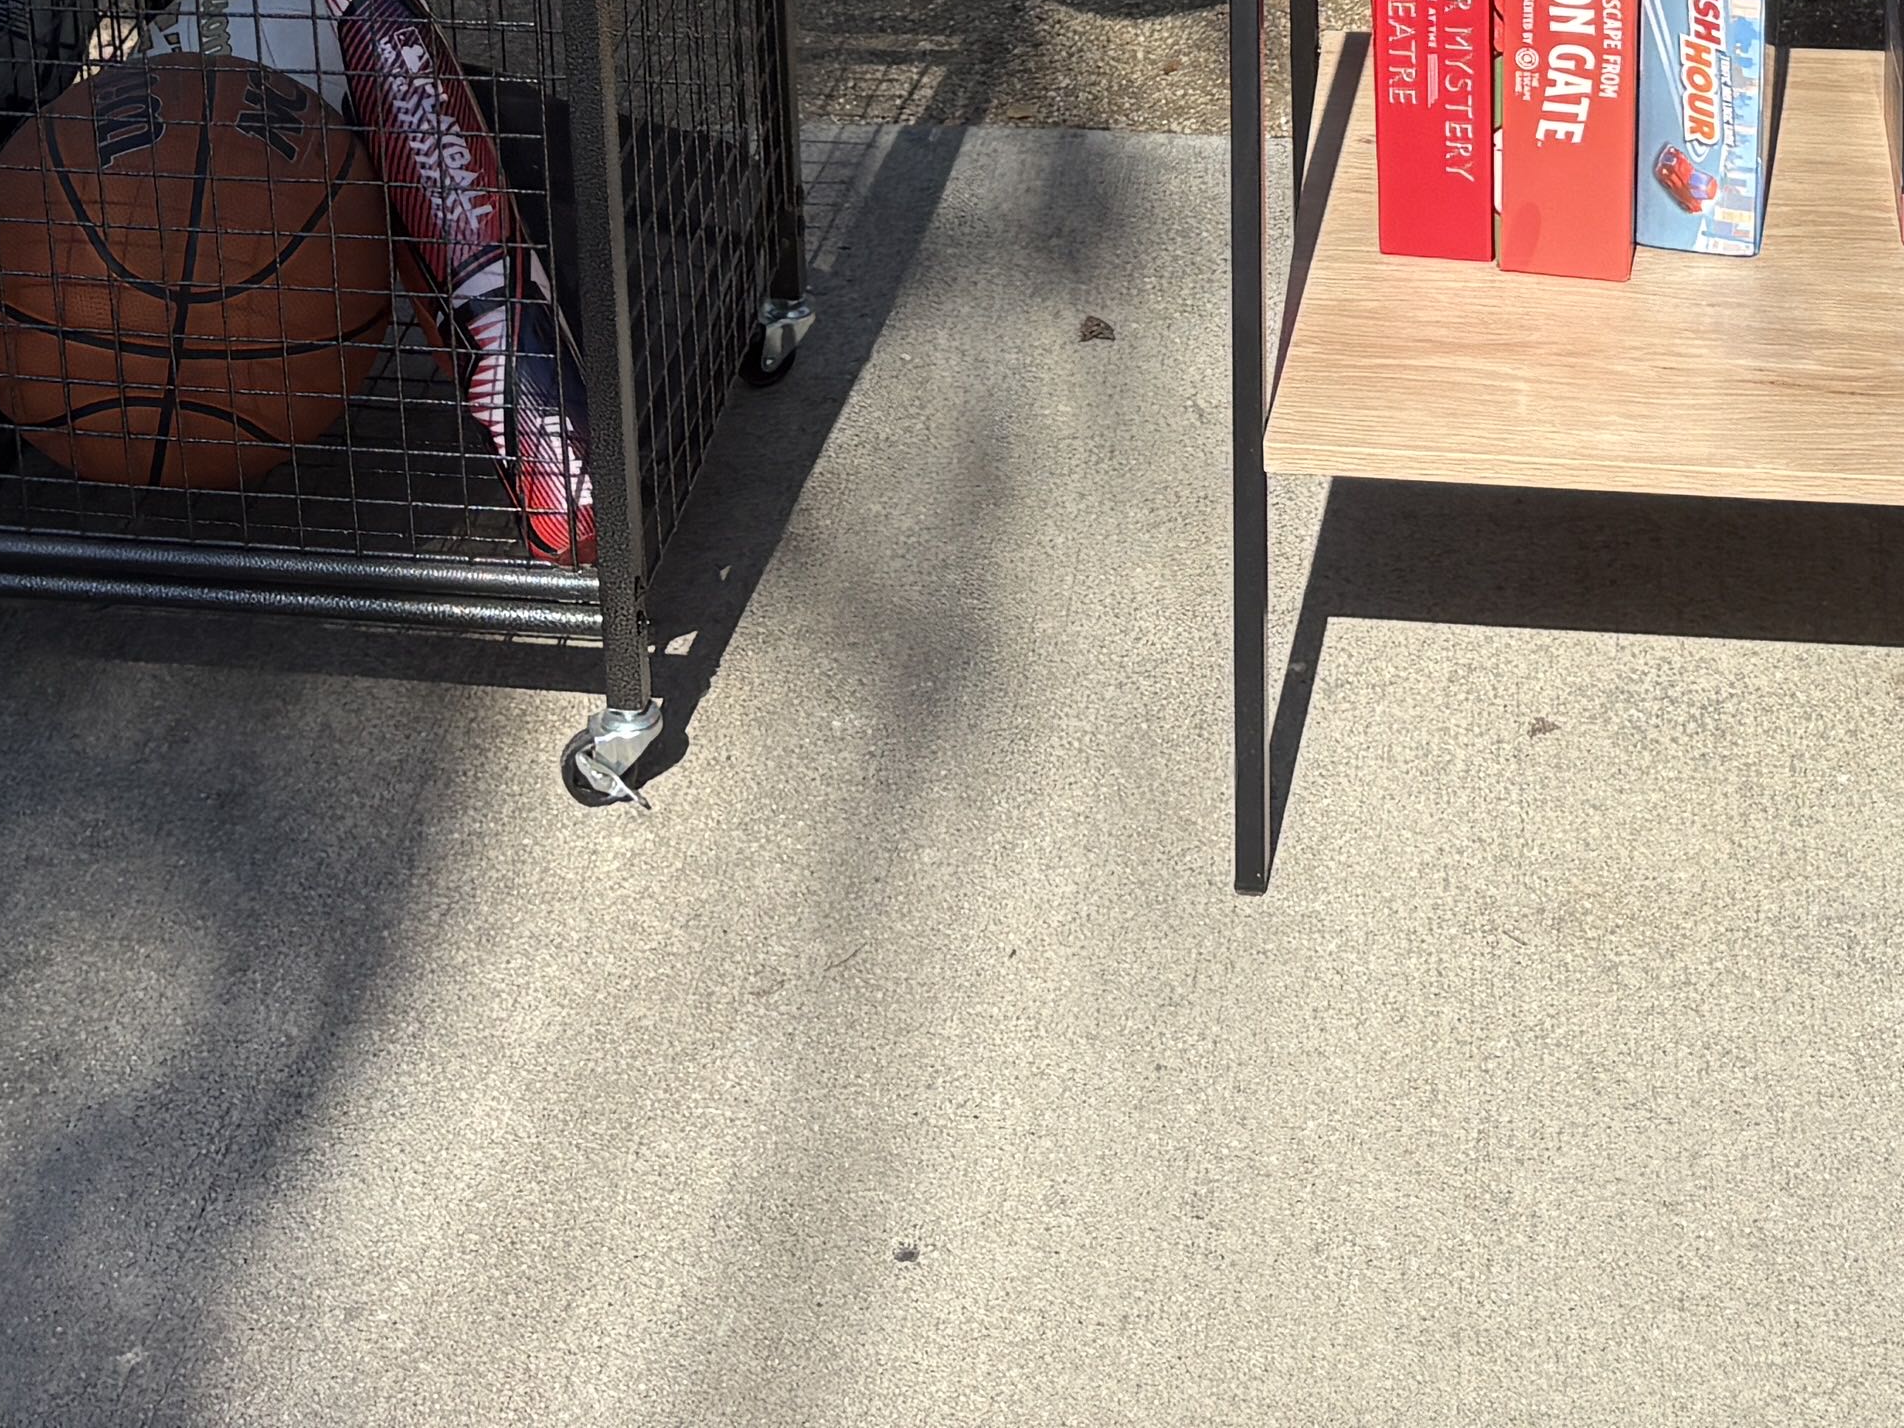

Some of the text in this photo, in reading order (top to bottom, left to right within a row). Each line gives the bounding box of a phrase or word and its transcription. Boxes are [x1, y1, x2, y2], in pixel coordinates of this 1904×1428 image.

[1443, 26, 1476, 184] MYSTERY
[1535, 43, 1595, 144] GATE
[1599, 54, 1622, 99] FROM
[1679, 39, 1721, 146] HOUR
